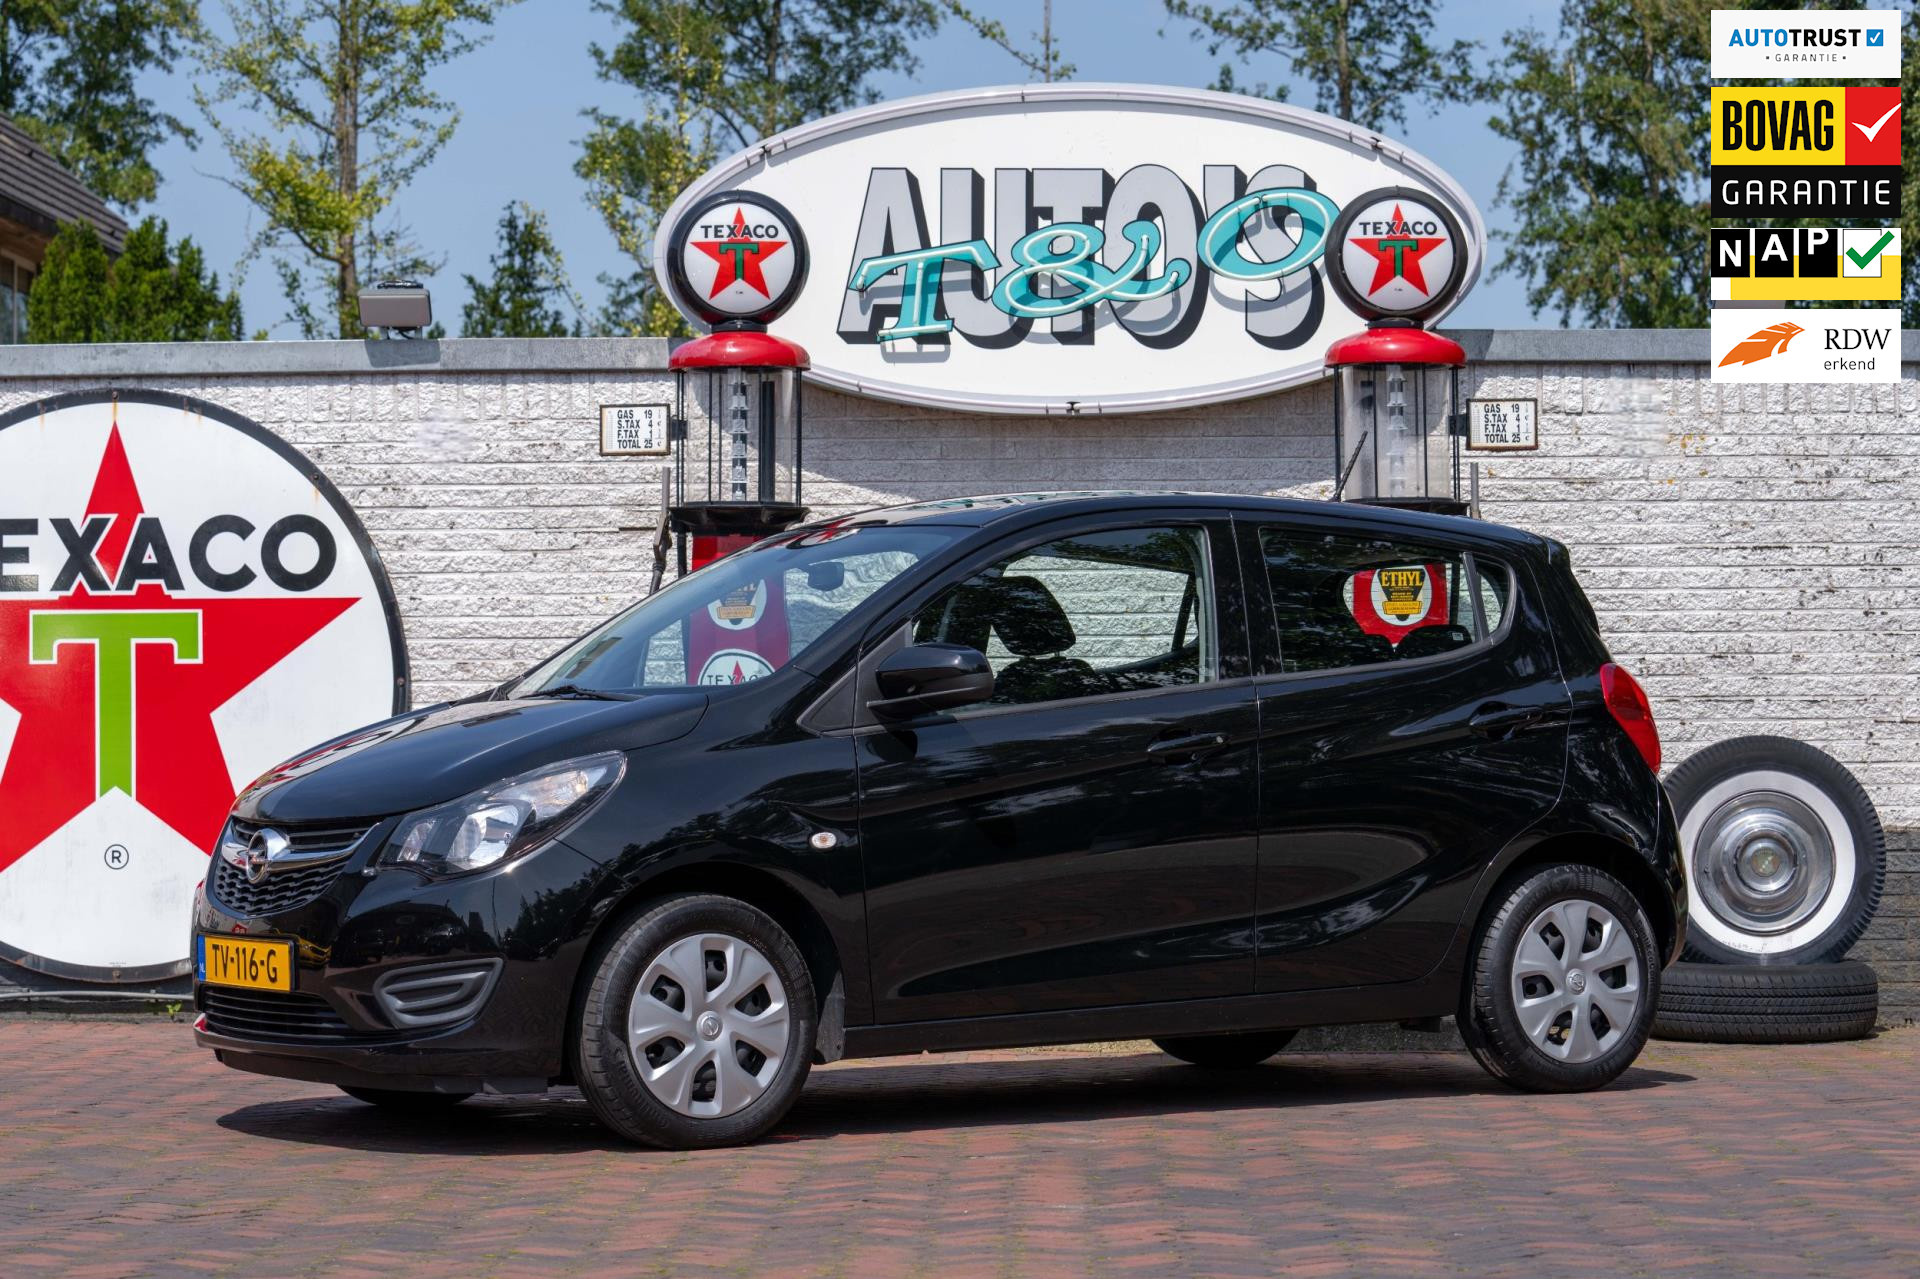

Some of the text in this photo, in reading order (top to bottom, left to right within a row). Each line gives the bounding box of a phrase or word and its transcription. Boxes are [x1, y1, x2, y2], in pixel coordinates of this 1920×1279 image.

[700, 224, 779, 239] TEXACO
[1359, 221, 1437, 235] TEXACO
[1484, 403, 1520, 413] GAS 19
[617, 409, 653, 419] GAS 19
[1484, 413, 1508, 423] S.TAX
[1515, 413, 1520, 423] 4
[617, 419, 640, 429] S.TAX
[648, 419, 653, 429] 4
[1484, 423, 1507, 433] F.TAX
[617, 429, 639, 439] F.TAX
[1485, 433, 1509, 443] TOTAL
[1511, 433, 1521, 443] 25
[617, 439, 641, 449] TOTAL
[644, 439, 653, 449] 25
[0, 514, 337, 592] EXACO
[1381, 571, 1423, 587] ETHYL
[212, 943, 278, 983] TV-116-G
